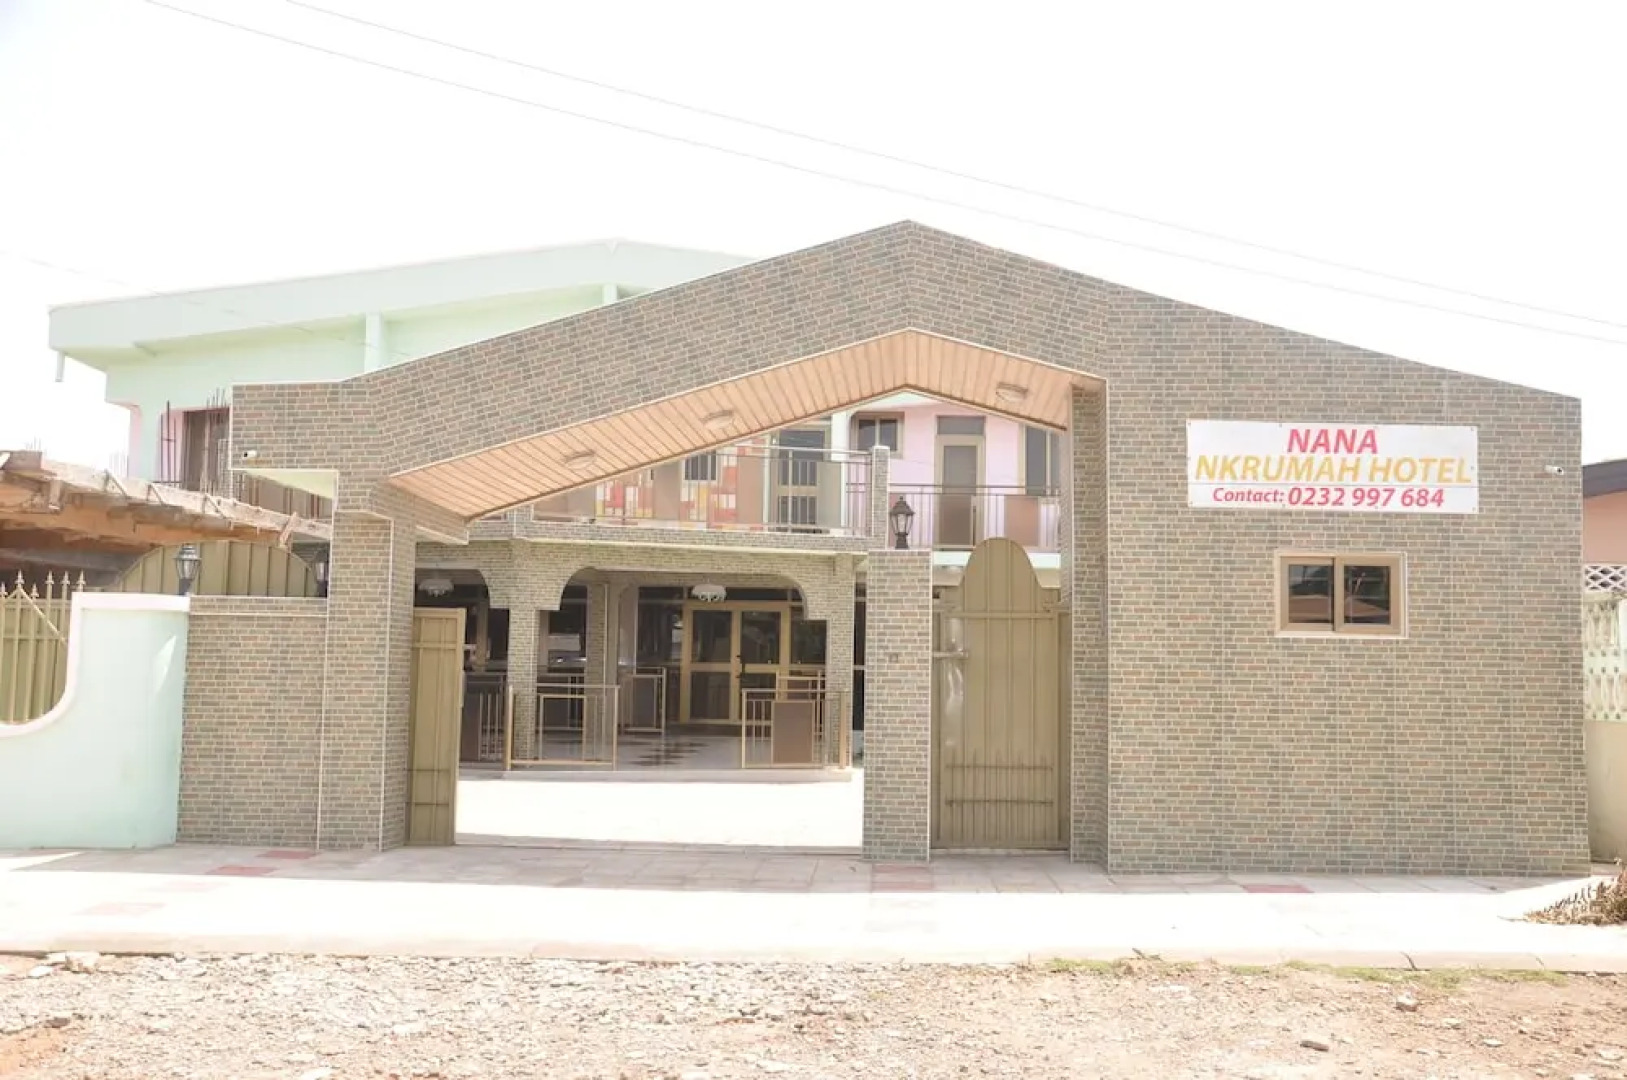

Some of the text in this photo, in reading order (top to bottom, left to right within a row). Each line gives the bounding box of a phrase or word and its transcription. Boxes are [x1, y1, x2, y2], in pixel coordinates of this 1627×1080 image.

[1287, 429, 1378, 454] NANA
[1195, 454, 1472, 483] NKRUMAH HOTEL
[1213, 487, 1444, 507] Contact: 0232 997 684
